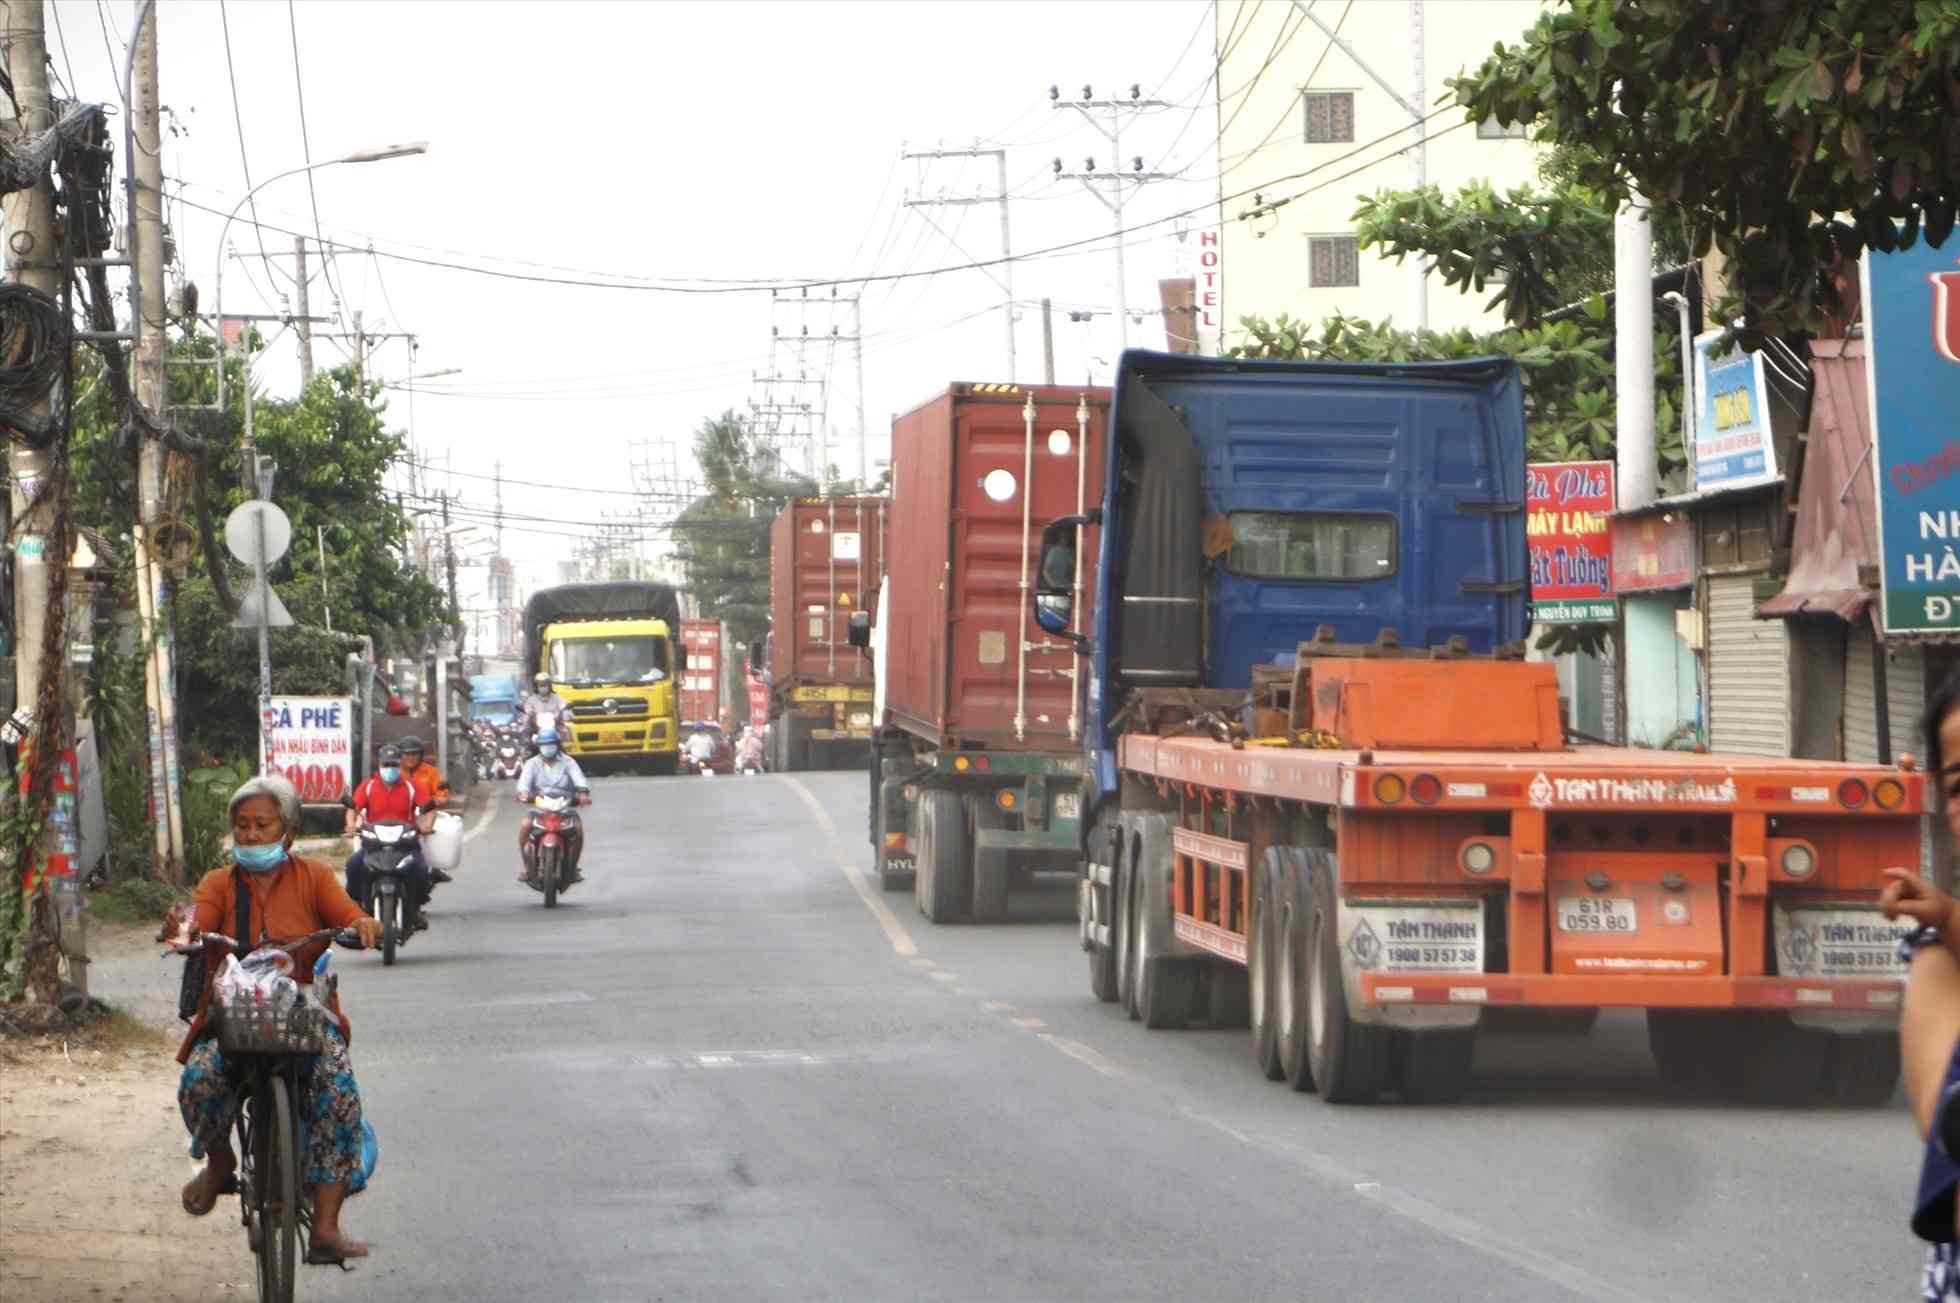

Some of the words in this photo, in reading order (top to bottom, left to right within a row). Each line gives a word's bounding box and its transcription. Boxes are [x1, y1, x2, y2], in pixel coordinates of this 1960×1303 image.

[1200, 232, 1217, 326] HOTEL
[301, 702, 341, 728] PHÊ
[1579, 901, 1614, 914] 61R
[1387, 918, 1419, 938] TÂN
[1422, 922, 1477, 938] THANH
[1567, 915, 1629, 930] 059.80
